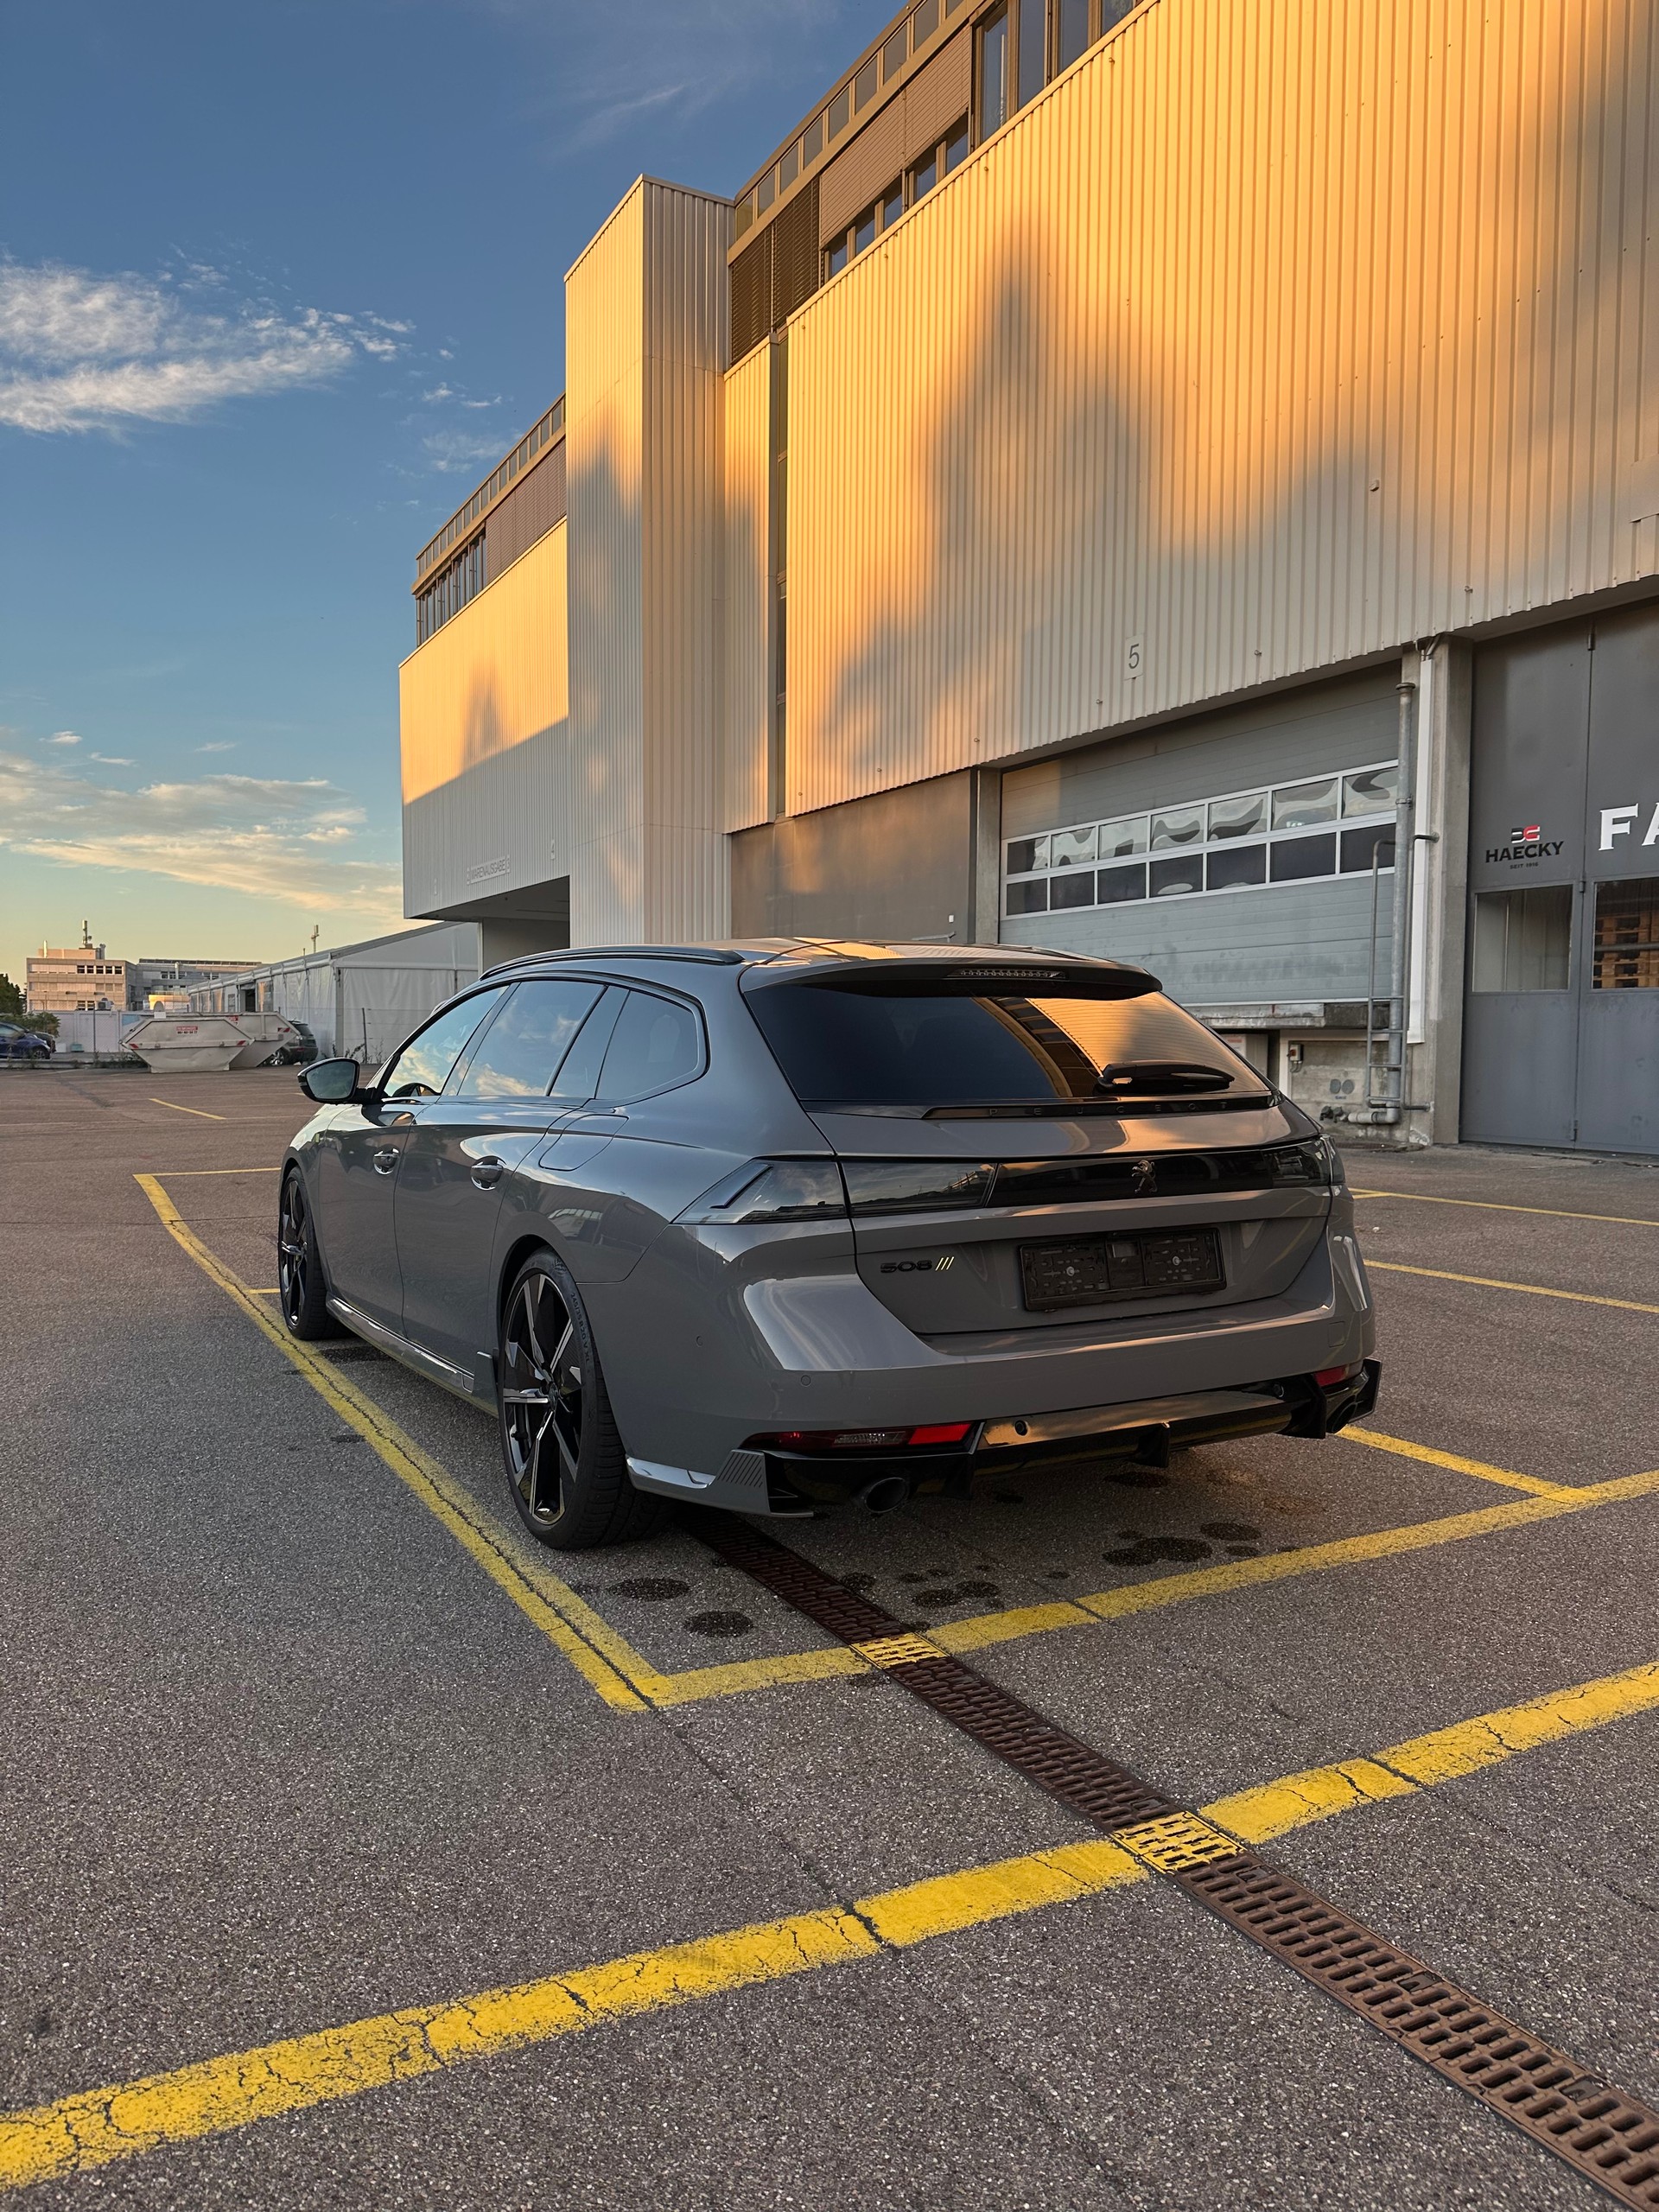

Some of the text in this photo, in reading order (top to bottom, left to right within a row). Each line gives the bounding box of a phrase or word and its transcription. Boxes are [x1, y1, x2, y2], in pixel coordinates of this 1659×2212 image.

[1128, 643, 1140, 670] 5
[1484, 841, 1564, 863] HAECKY
[988, 1102, 1227, 1117] PEUGEOT
[880, 1259, 933, 1274] 508
